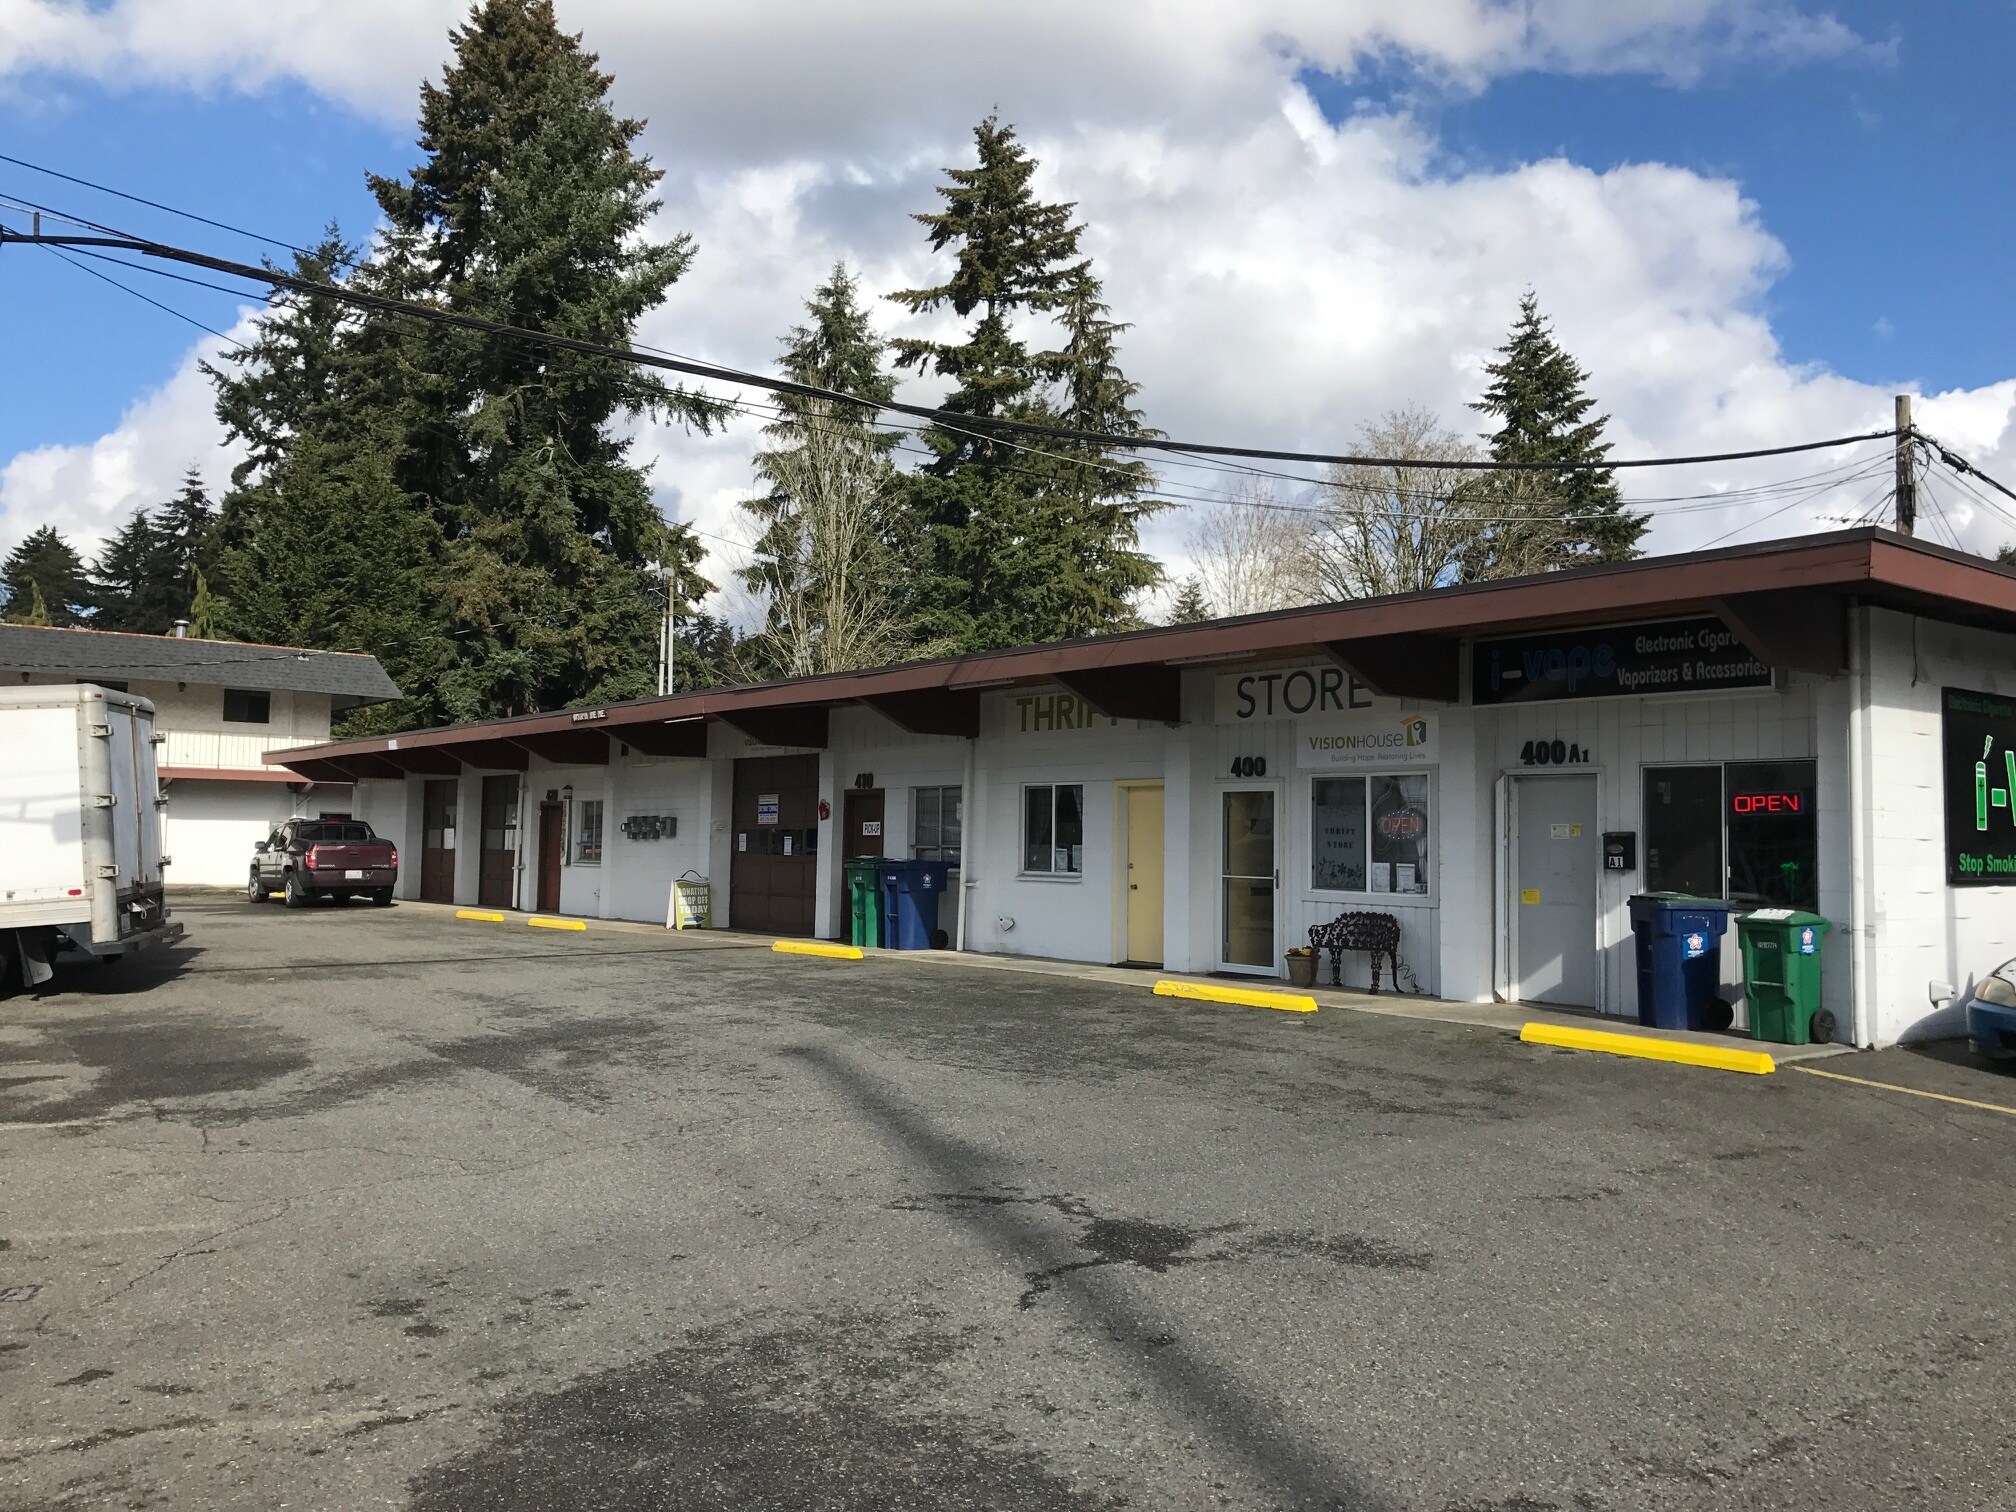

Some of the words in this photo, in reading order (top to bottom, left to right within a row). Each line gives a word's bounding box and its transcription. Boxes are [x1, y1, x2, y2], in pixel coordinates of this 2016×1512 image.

[1635, 631, 1695, 654] Electronic
[1698, 629, 1741, 652] Cigare
[1491, 644, 1616, 692] i-vape
[1617, 667, 1678, 690] Vaporizers
[1682, 662, 1693, 681] &
[1696, 656, 1768, 680] Accessories
[1236, 668, 1372, 718] STORE
[1016, 694, 1118, 732] THRIF
[1331, 754, 1356, 763] Building
[1378, 752, 1408, 761] Restoring
[1231, 757, 1267, 778] 400
[1734, 795, 1799, 812] OPEN
[864, 823, 880, 834] PICK-UP
[1324, 827, 1356, 835] THRIFT
[1381, 816, 1420, 834] OPEN
[1326, 841, 1354, 849] STORE
[1609, 856, 1622, 868] A1
[1959, 853, 1984, 876] Stop
[697, 896, 708, 905] OFF
[679, 905, 708, 914] TODAY
